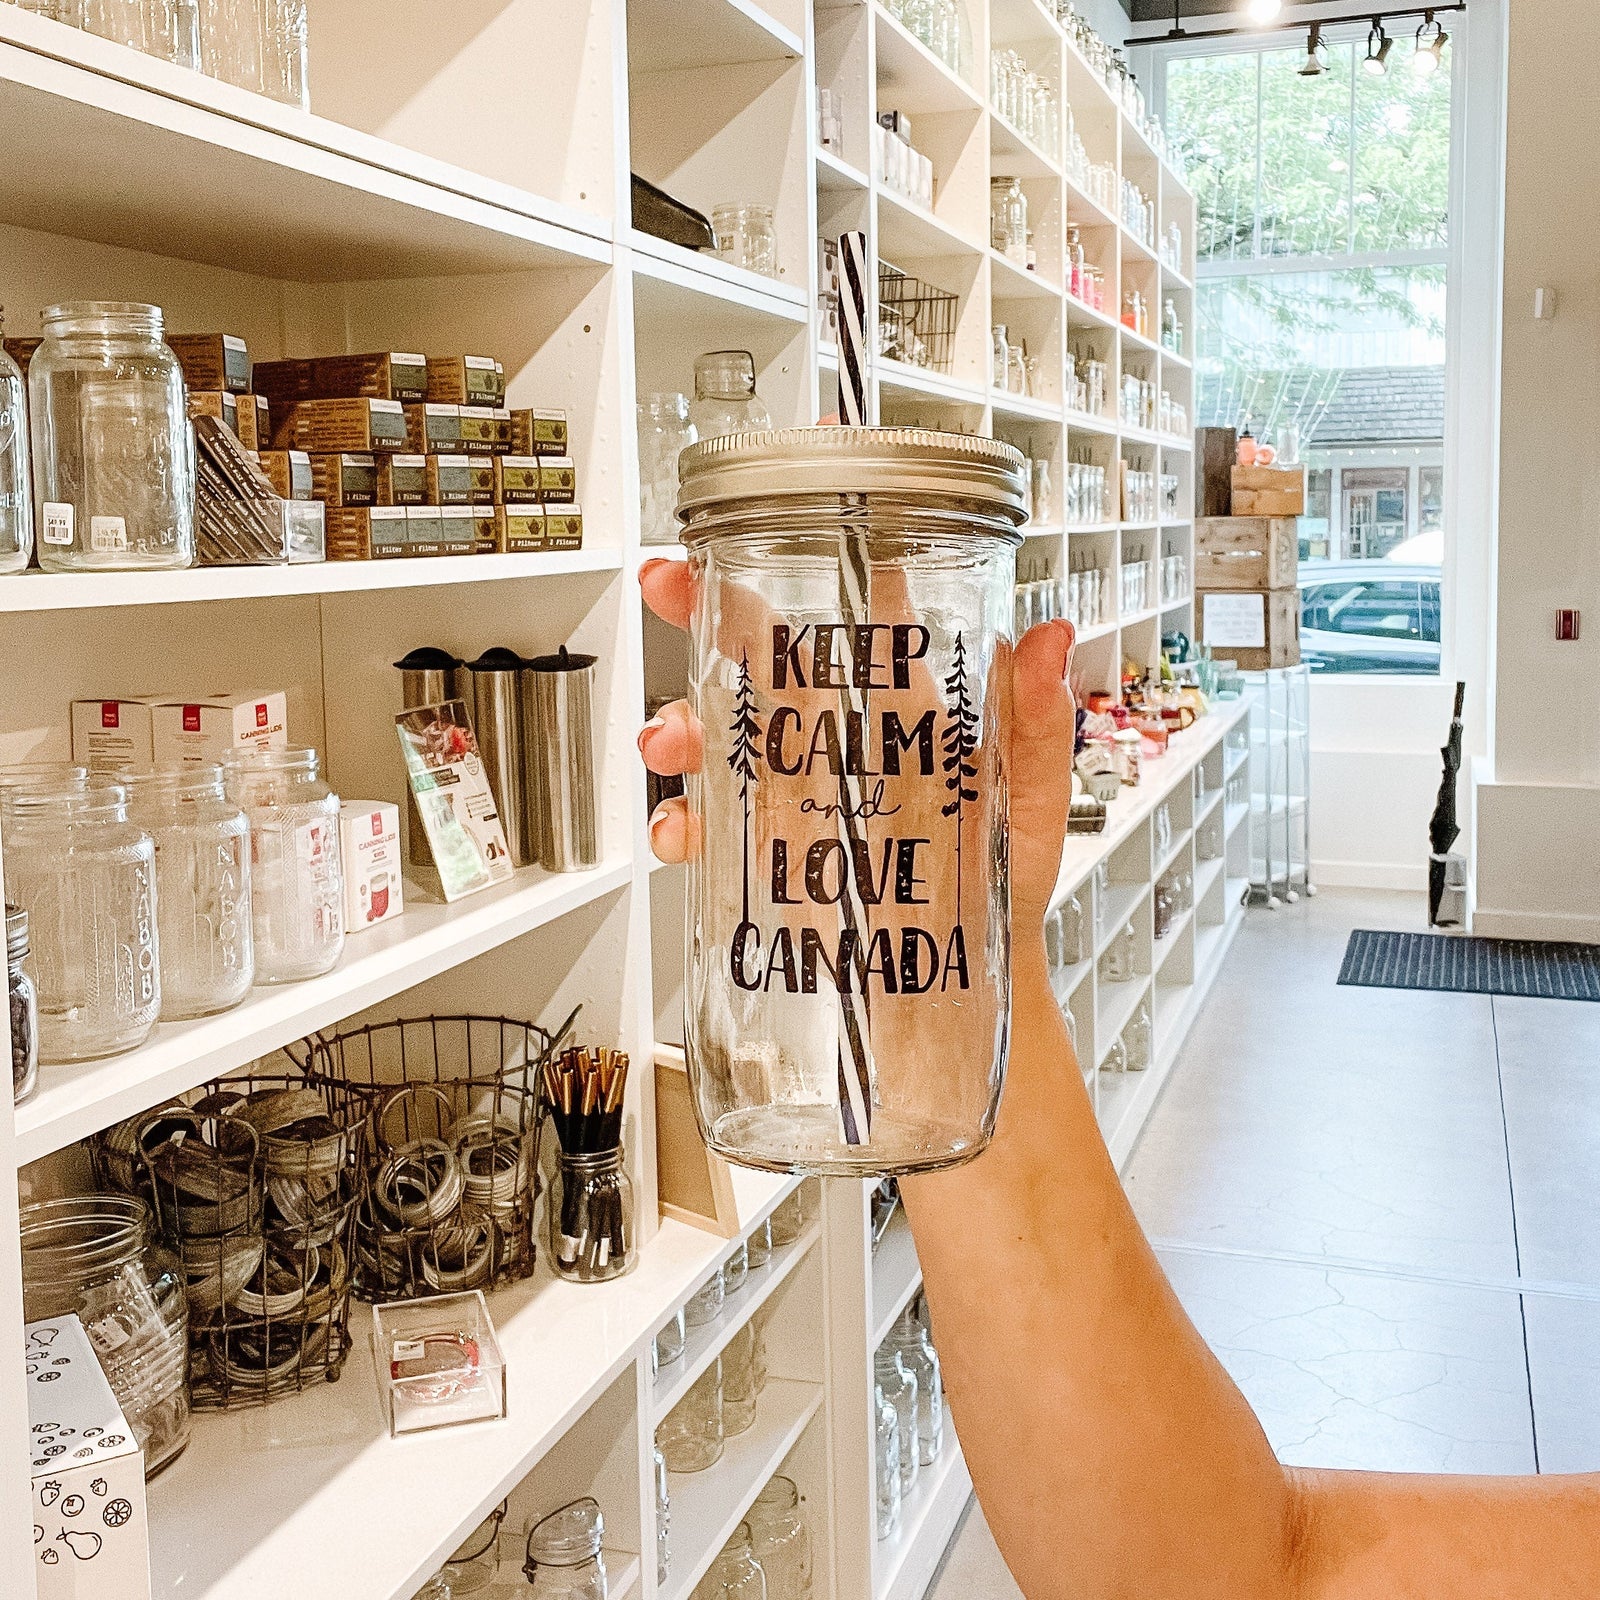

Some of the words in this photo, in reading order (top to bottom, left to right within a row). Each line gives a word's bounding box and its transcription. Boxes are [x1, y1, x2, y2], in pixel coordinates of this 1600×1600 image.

[382, 438, 402, 446] Filter
[772, 623, 930, 690] KEEP
[765, 706, 937, 776] CALM
[800, 779, 901, 820] and
[771, 838, 930, 905] LOVE
[730, 921, 970, 995] CANADA
